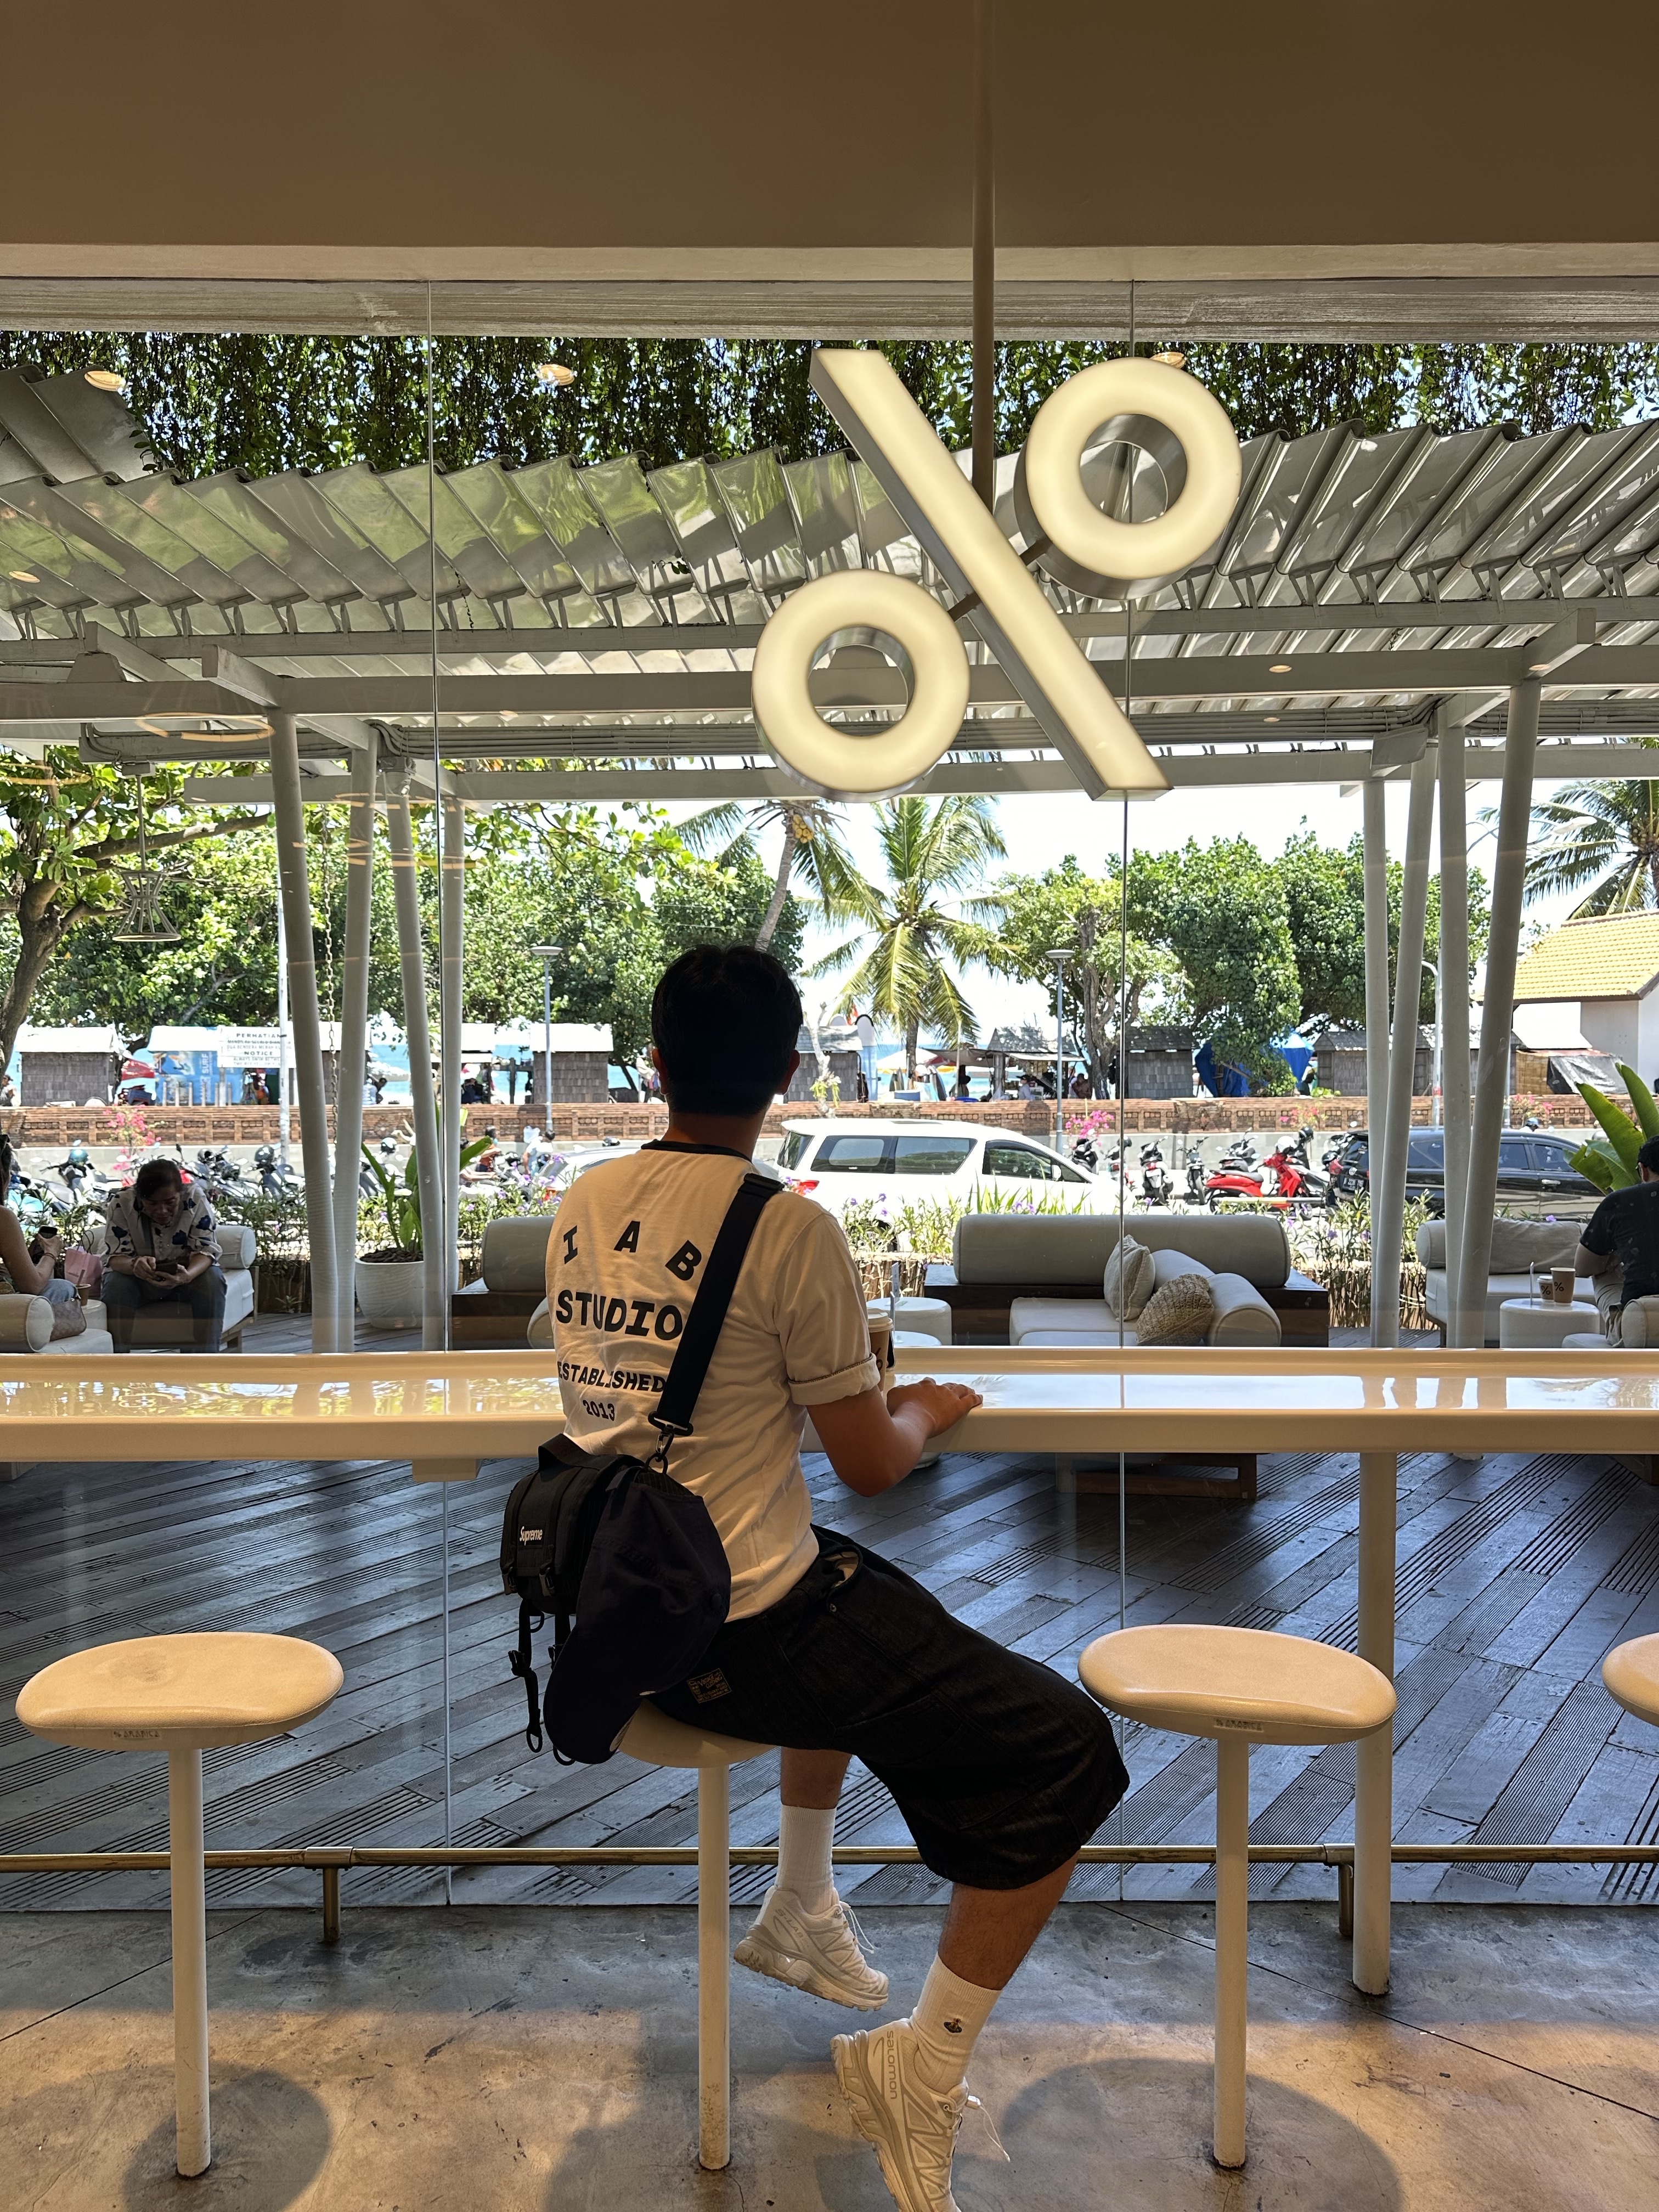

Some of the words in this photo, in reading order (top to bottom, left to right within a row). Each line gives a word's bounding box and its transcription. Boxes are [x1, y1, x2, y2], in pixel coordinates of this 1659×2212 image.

[556, 1289, 684, 1341] STUDIO
[582, 1400, 615, 1421] 2013
[520, 1526, 543, 1546] Supreme
